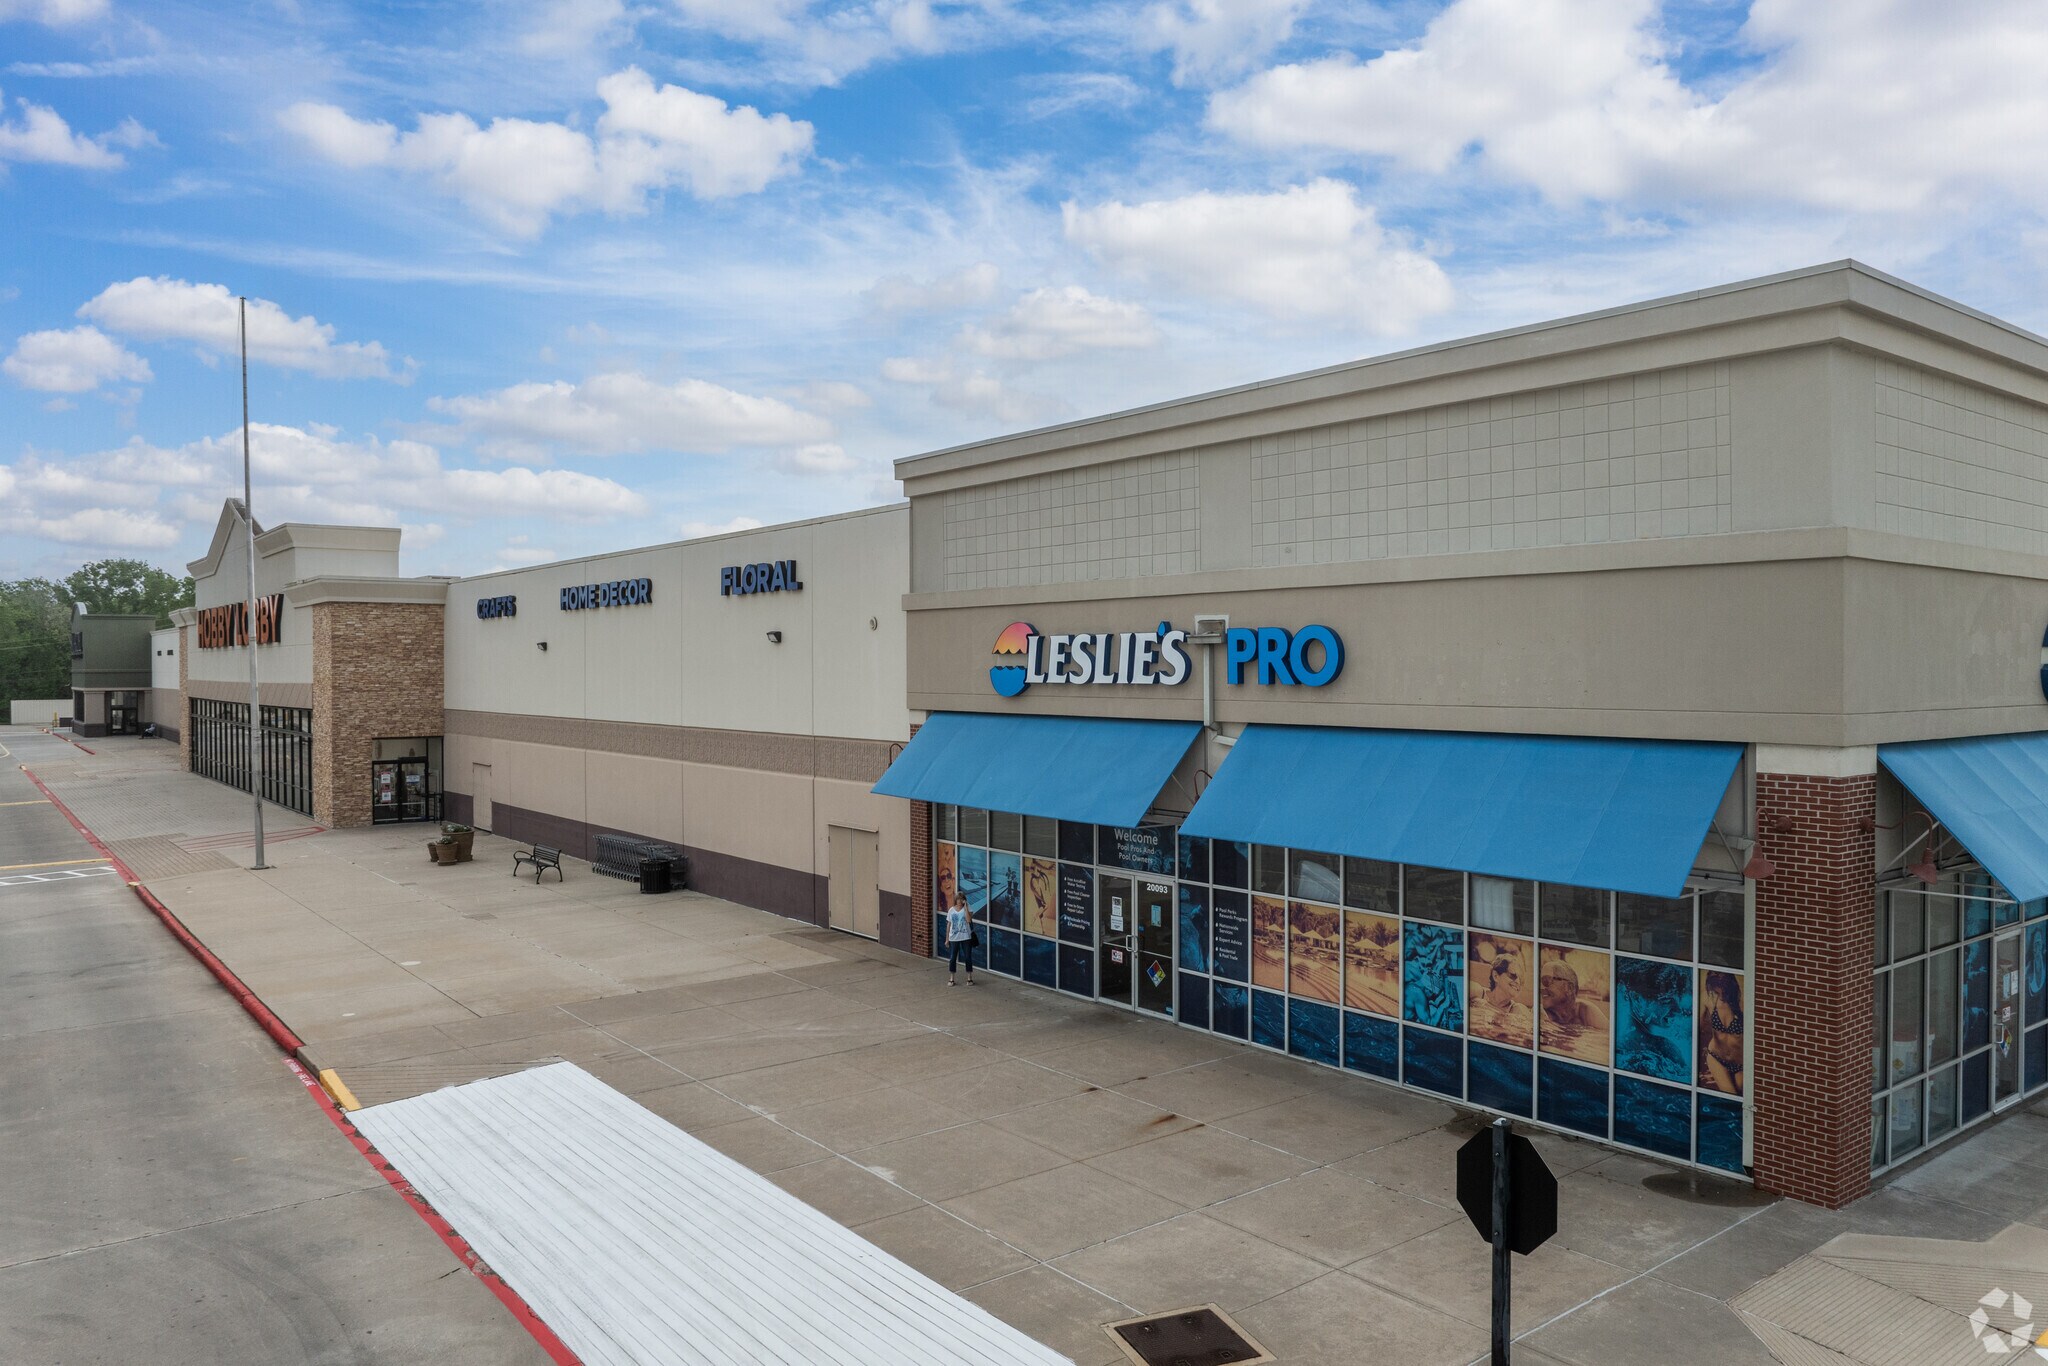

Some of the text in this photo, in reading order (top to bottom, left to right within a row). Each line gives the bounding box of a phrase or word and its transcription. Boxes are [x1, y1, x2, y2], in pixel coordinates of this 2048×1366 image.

[721, 560, 803, 596] FLORAL
[477, 595, 517, 619] CRAFTS
[559, 578, 653, 612] HOME DECOR
[197, 604, 235, 649] HOBBY
[1025, 621, 1345, 687] LESLIE'S PRO
[1114, 828, 1159, 845] Welcome
[1117, 843, 1129, 851] Pool
[1119, 852, 1131, 860] Pool
[1146, 883, 1168, 894] 20093
